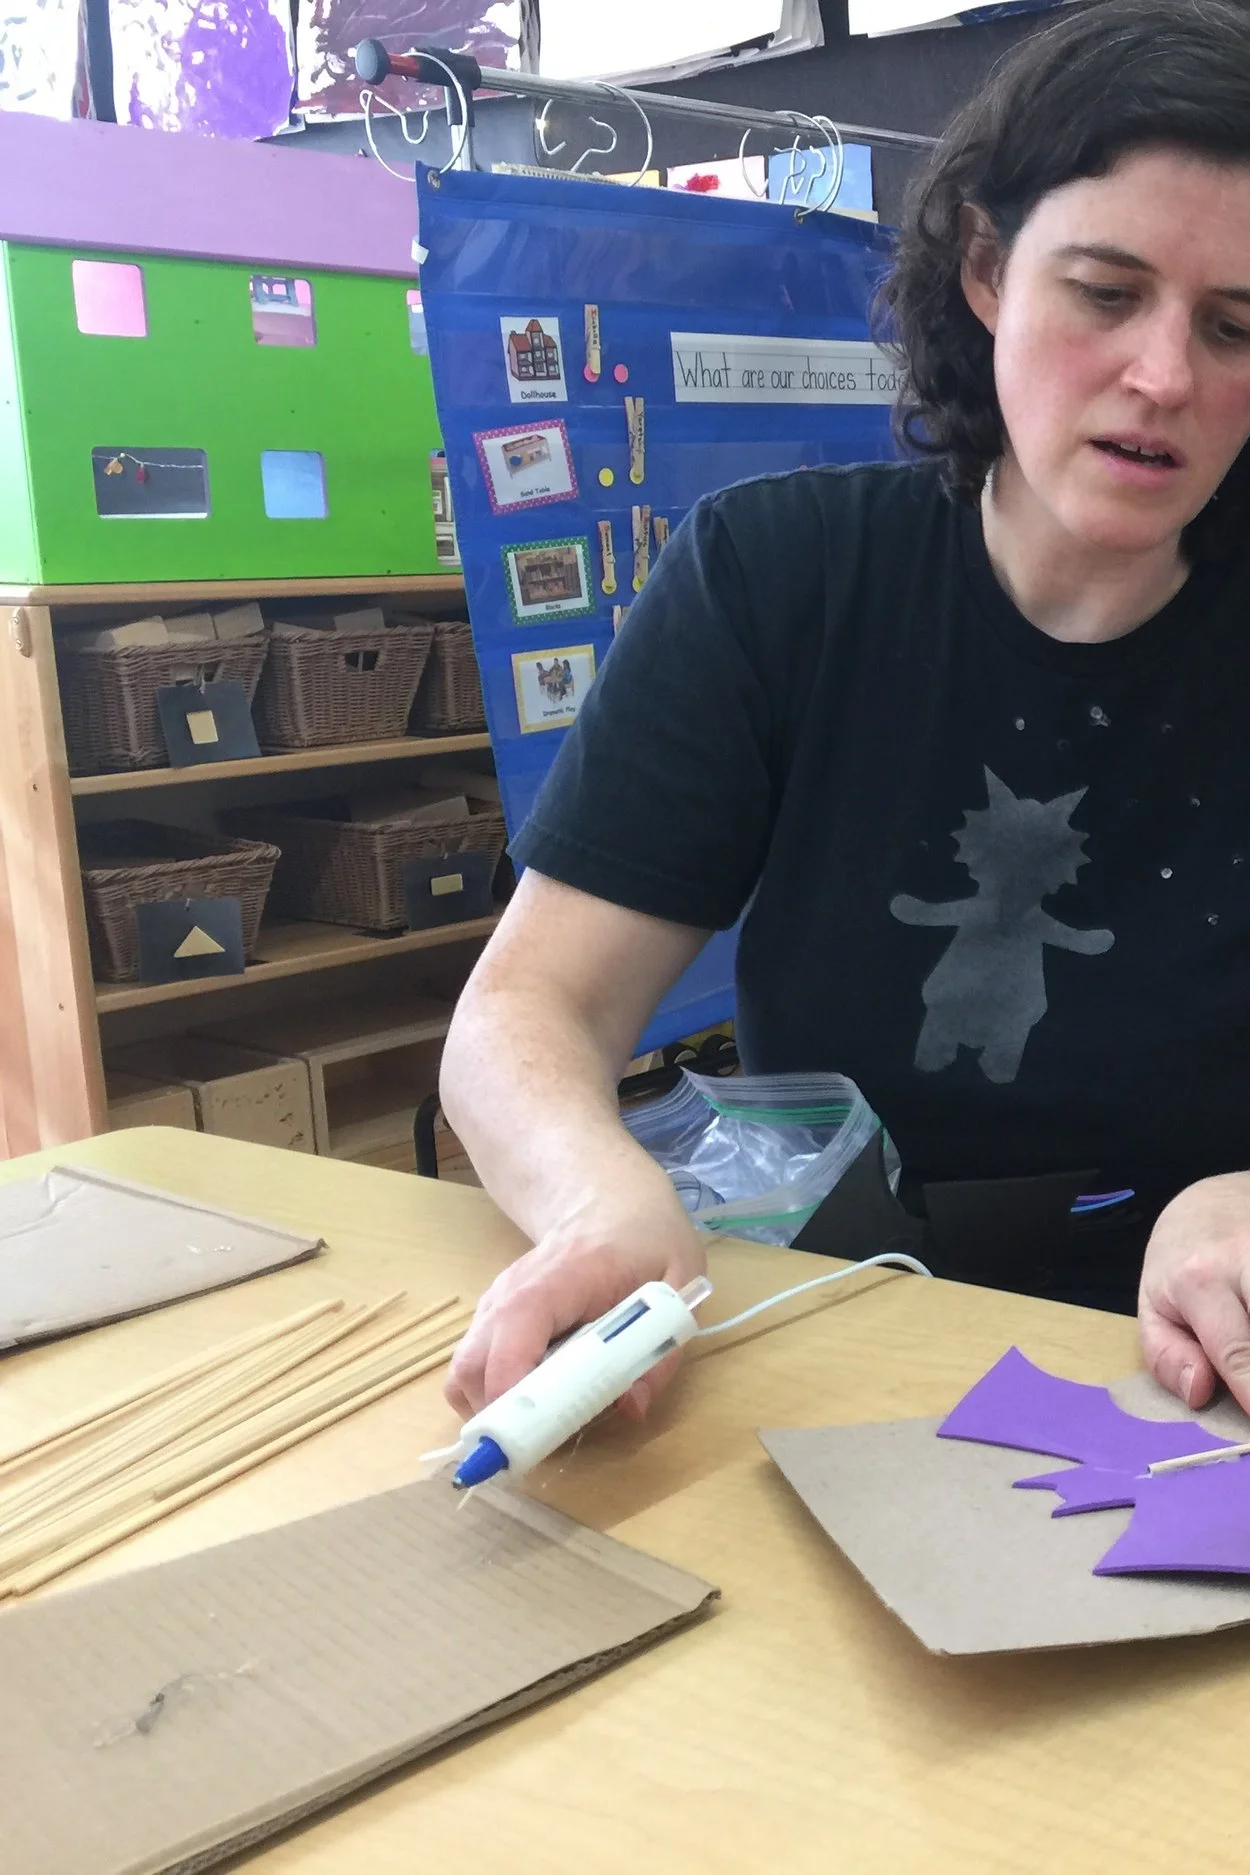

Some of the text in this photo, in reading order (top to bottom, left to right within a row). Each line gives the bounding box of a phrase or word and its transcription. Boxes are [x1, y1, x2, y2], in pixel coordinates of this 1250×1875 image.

[675, 351, 732, 388] What
[741, 368, 766, 389] are
[770, 369, 796, 389] our
[801, 355, 857, 391] choices
[520, 390, 557, 400] Dollhouse
